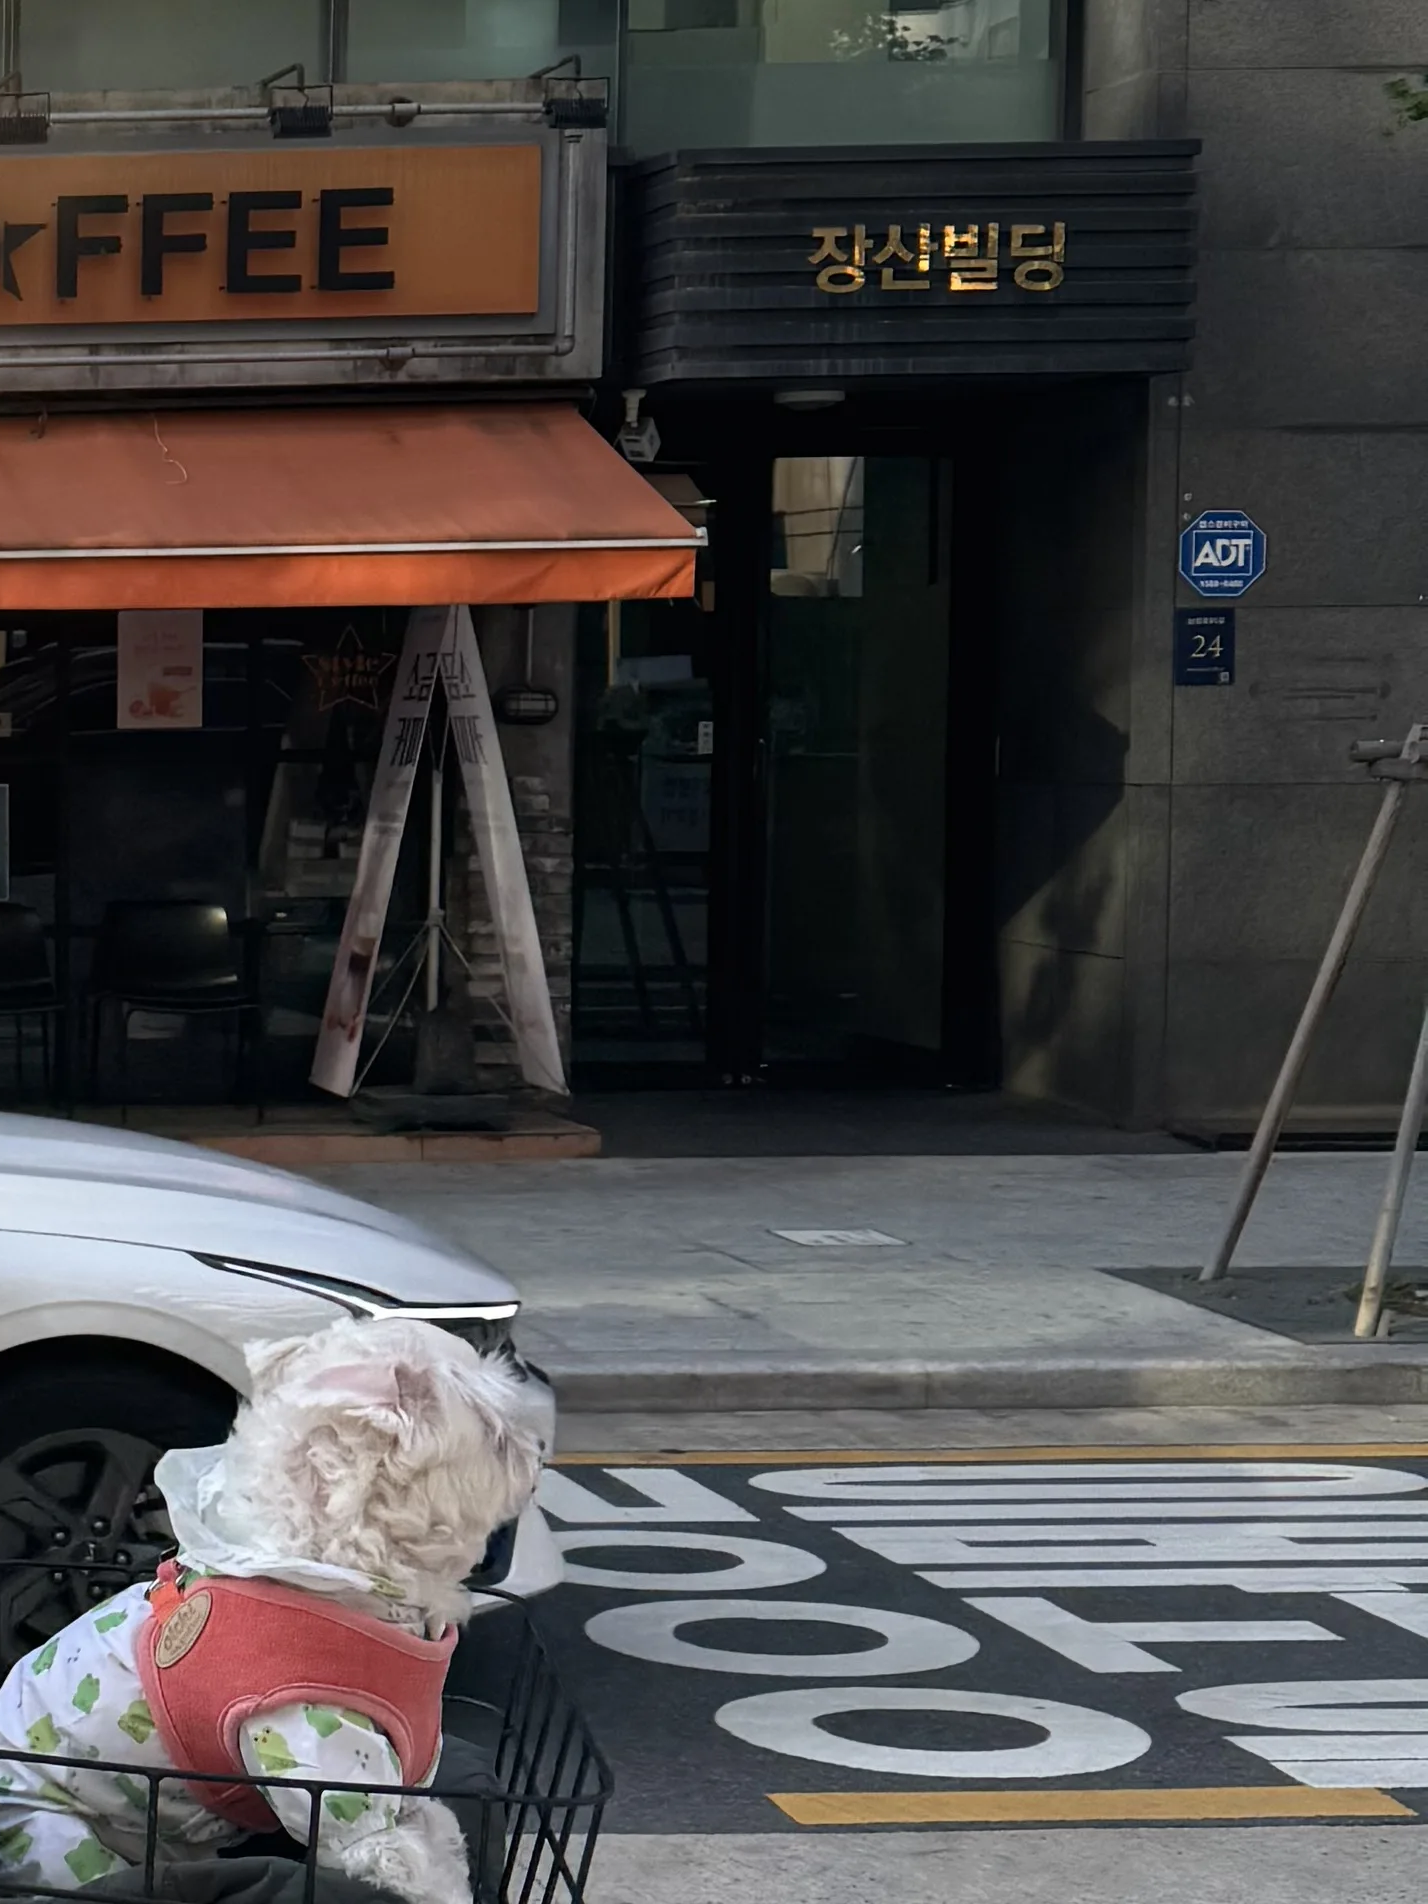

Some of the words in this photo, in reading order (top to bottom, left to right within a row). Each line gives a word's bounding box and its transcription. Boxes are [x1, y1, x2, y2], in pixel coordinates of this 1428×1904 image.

[807, 220, 1067, 294] 장산빌딩
[1194, 538, 1252, 567] ADT
[1190, 634, 1225, 659] 24
